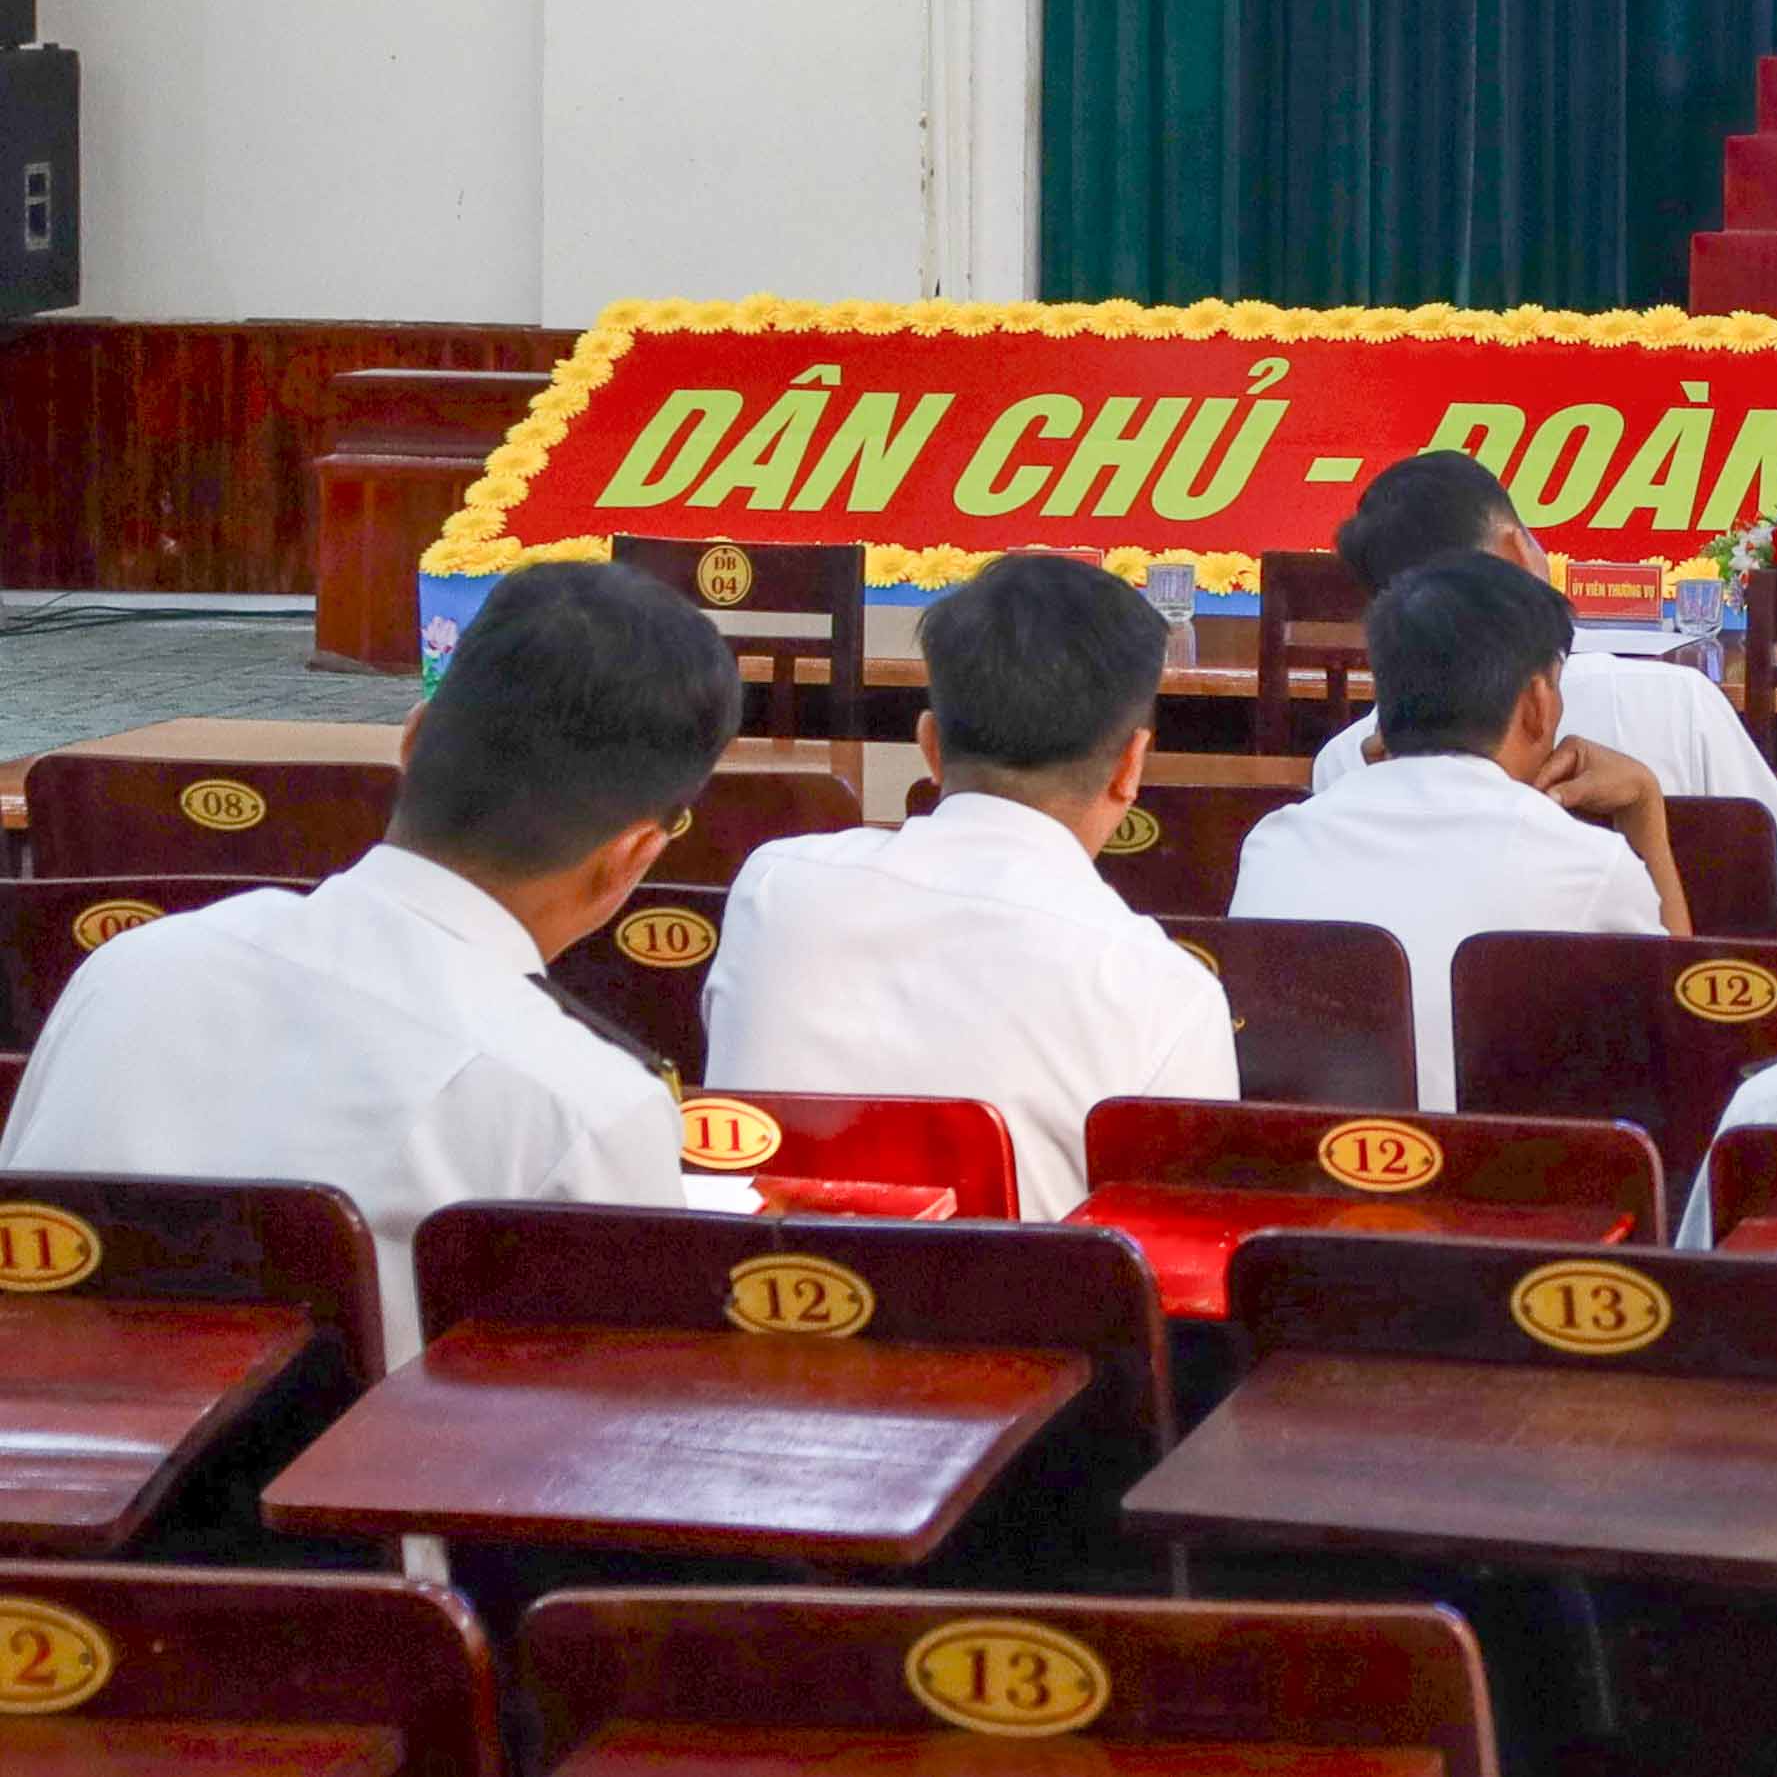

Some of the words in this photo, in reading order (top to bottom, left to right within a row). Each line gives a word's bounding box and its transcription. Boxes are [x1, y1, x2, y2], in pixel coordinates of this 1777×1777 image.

[596, 365, 954, 511] DÂN
[954, 358, 1289, 520] CHỦ
[711, 576, 737, 594] 04
[200, 791, 244, 820] 08
[643, 922, 692, 954] 10
[1704, 975, 1754, 1008] 12
[693, 1117, 744, 1151] 11
[1352, 1137, 1409, 1175] 12
[0, 1227, 56, 1270] 11
[761, 1277, 832, 1324] 12
[1562, 1284, 1627, 1331] 13
[964, 1649, 1051, 1708] 13
